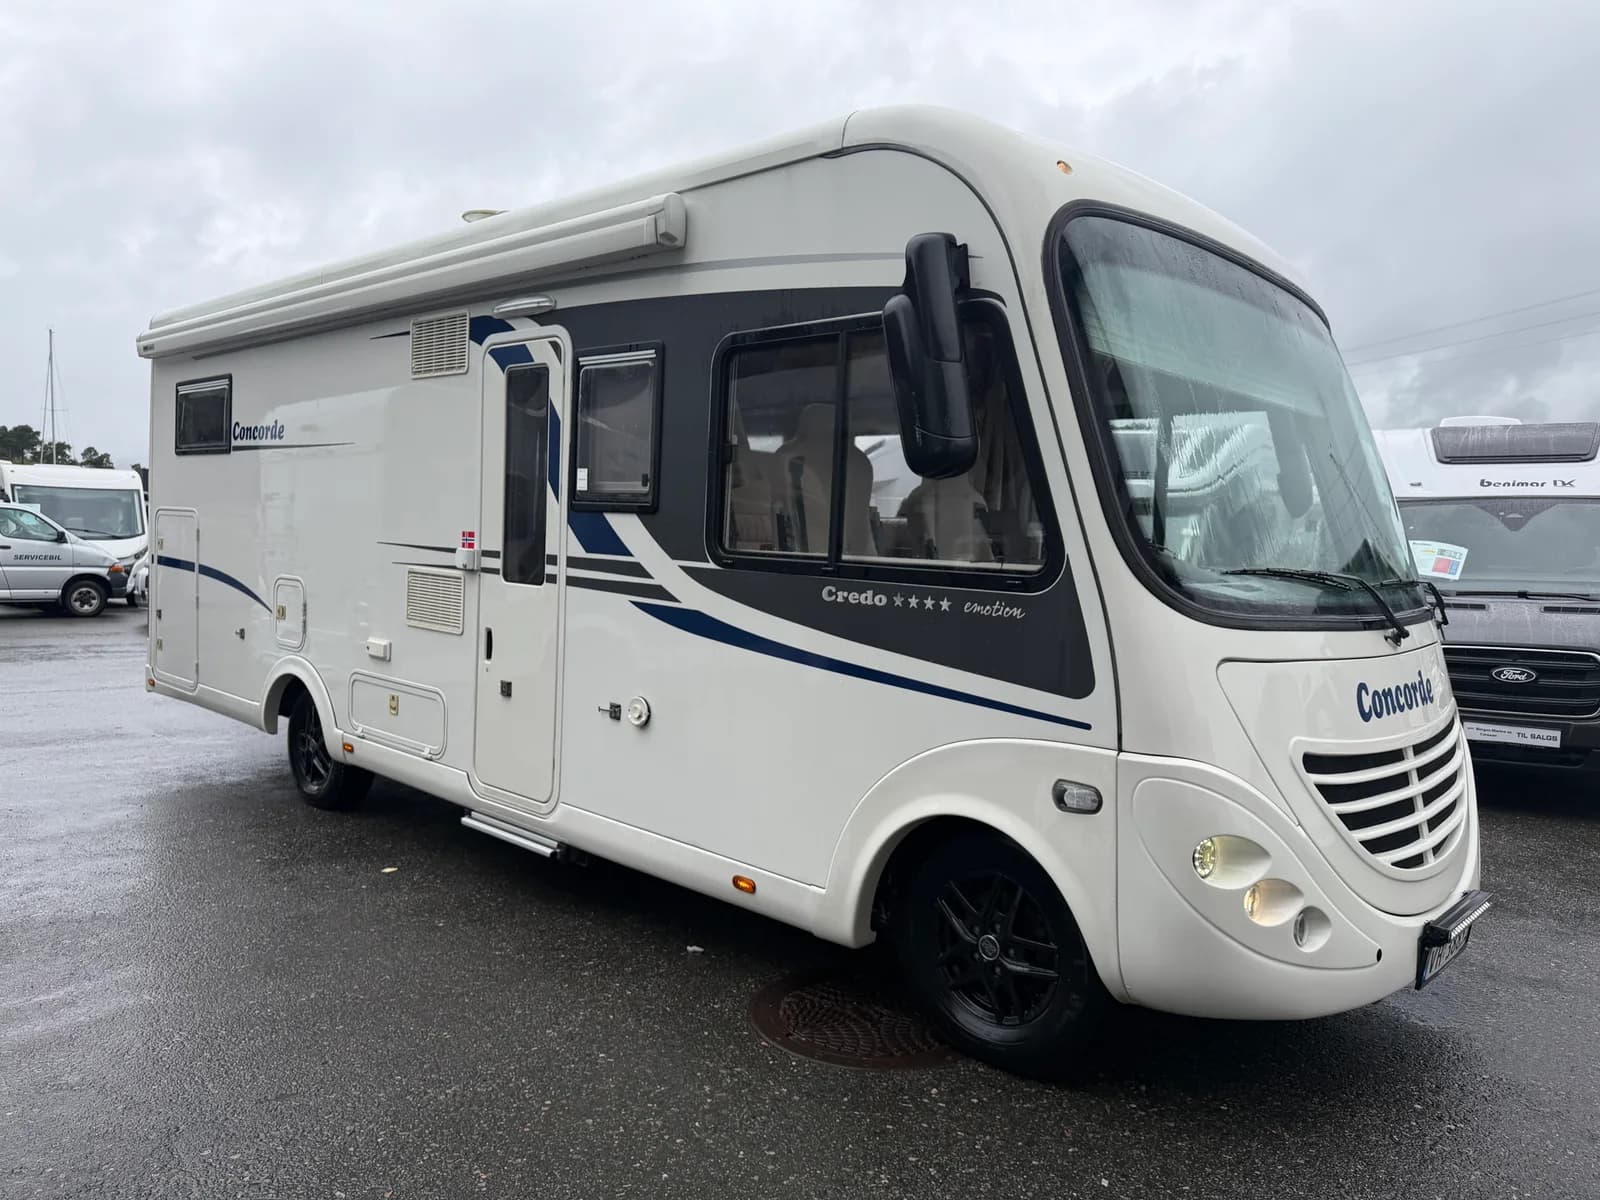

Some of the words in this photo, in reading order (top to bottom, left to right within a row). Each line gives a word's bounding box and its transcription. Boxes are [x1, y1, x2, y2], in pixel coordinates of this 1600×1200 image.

[232, 419, 285, 440] Concorde
[821, 585, 888, 606] Credo
[963, 600, 1026, 619] emotion
[1500, 669, 1528, 681] Ford
[1356, 669, 1434, 723] Concorde
[1516, 731, 1529, 739] TIL
